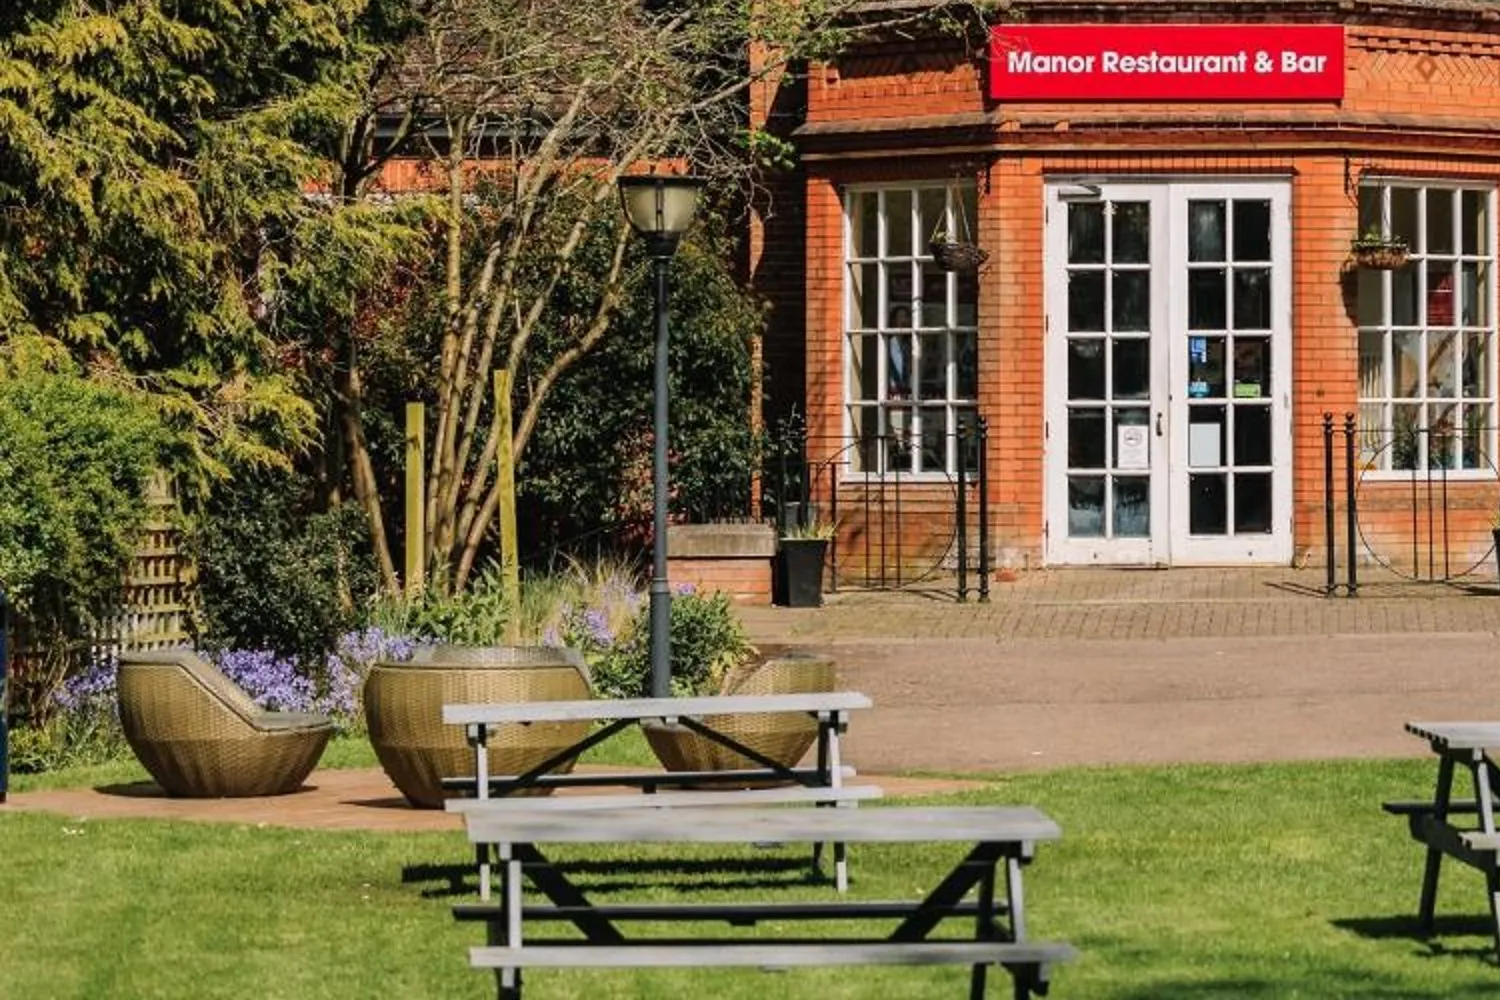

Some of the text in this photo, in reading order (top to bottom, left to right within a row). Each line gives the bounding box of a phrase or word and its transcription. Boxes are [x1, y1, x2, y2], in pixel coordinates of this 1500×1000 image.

[1008, 51, 1327, 73] Manor Restaurant & Bar
